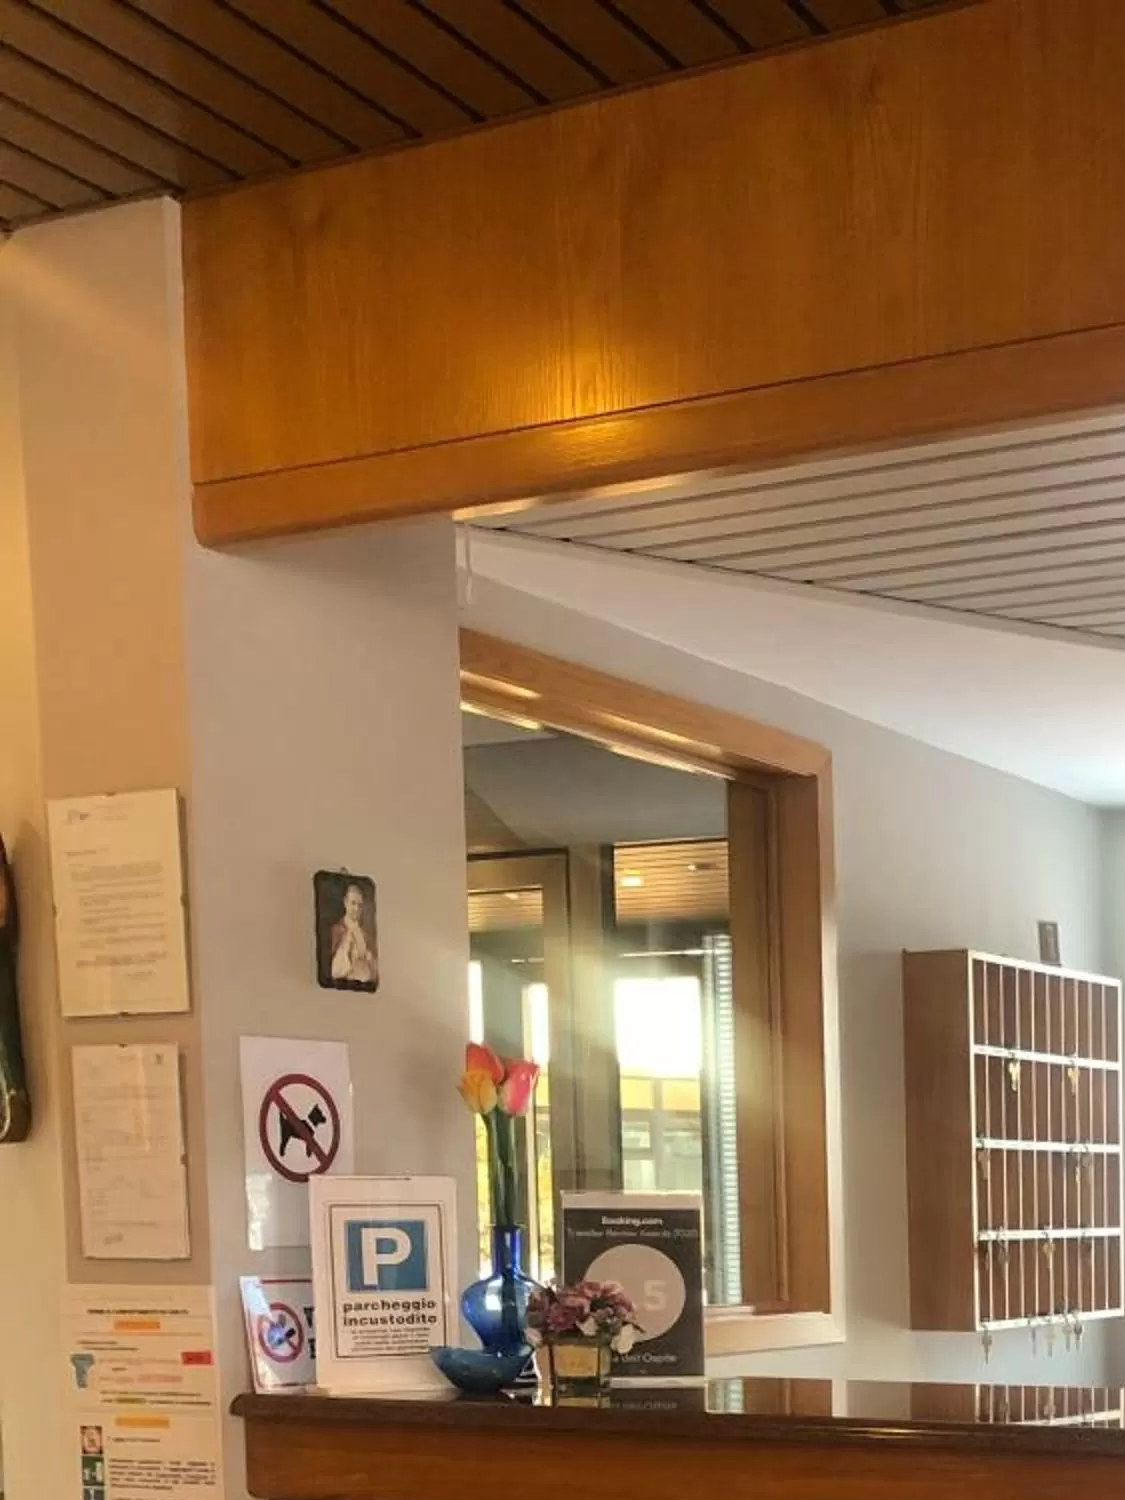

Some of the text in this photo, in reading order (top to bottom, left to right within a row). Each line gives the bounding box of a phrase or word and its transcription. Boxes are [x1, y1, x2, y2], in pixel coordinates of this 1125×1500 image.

[361, 1227, 411, 1285] P
[343, 1298, 436, 1313] parcheggio
[343, 1313, 437, 1326] incustodito
